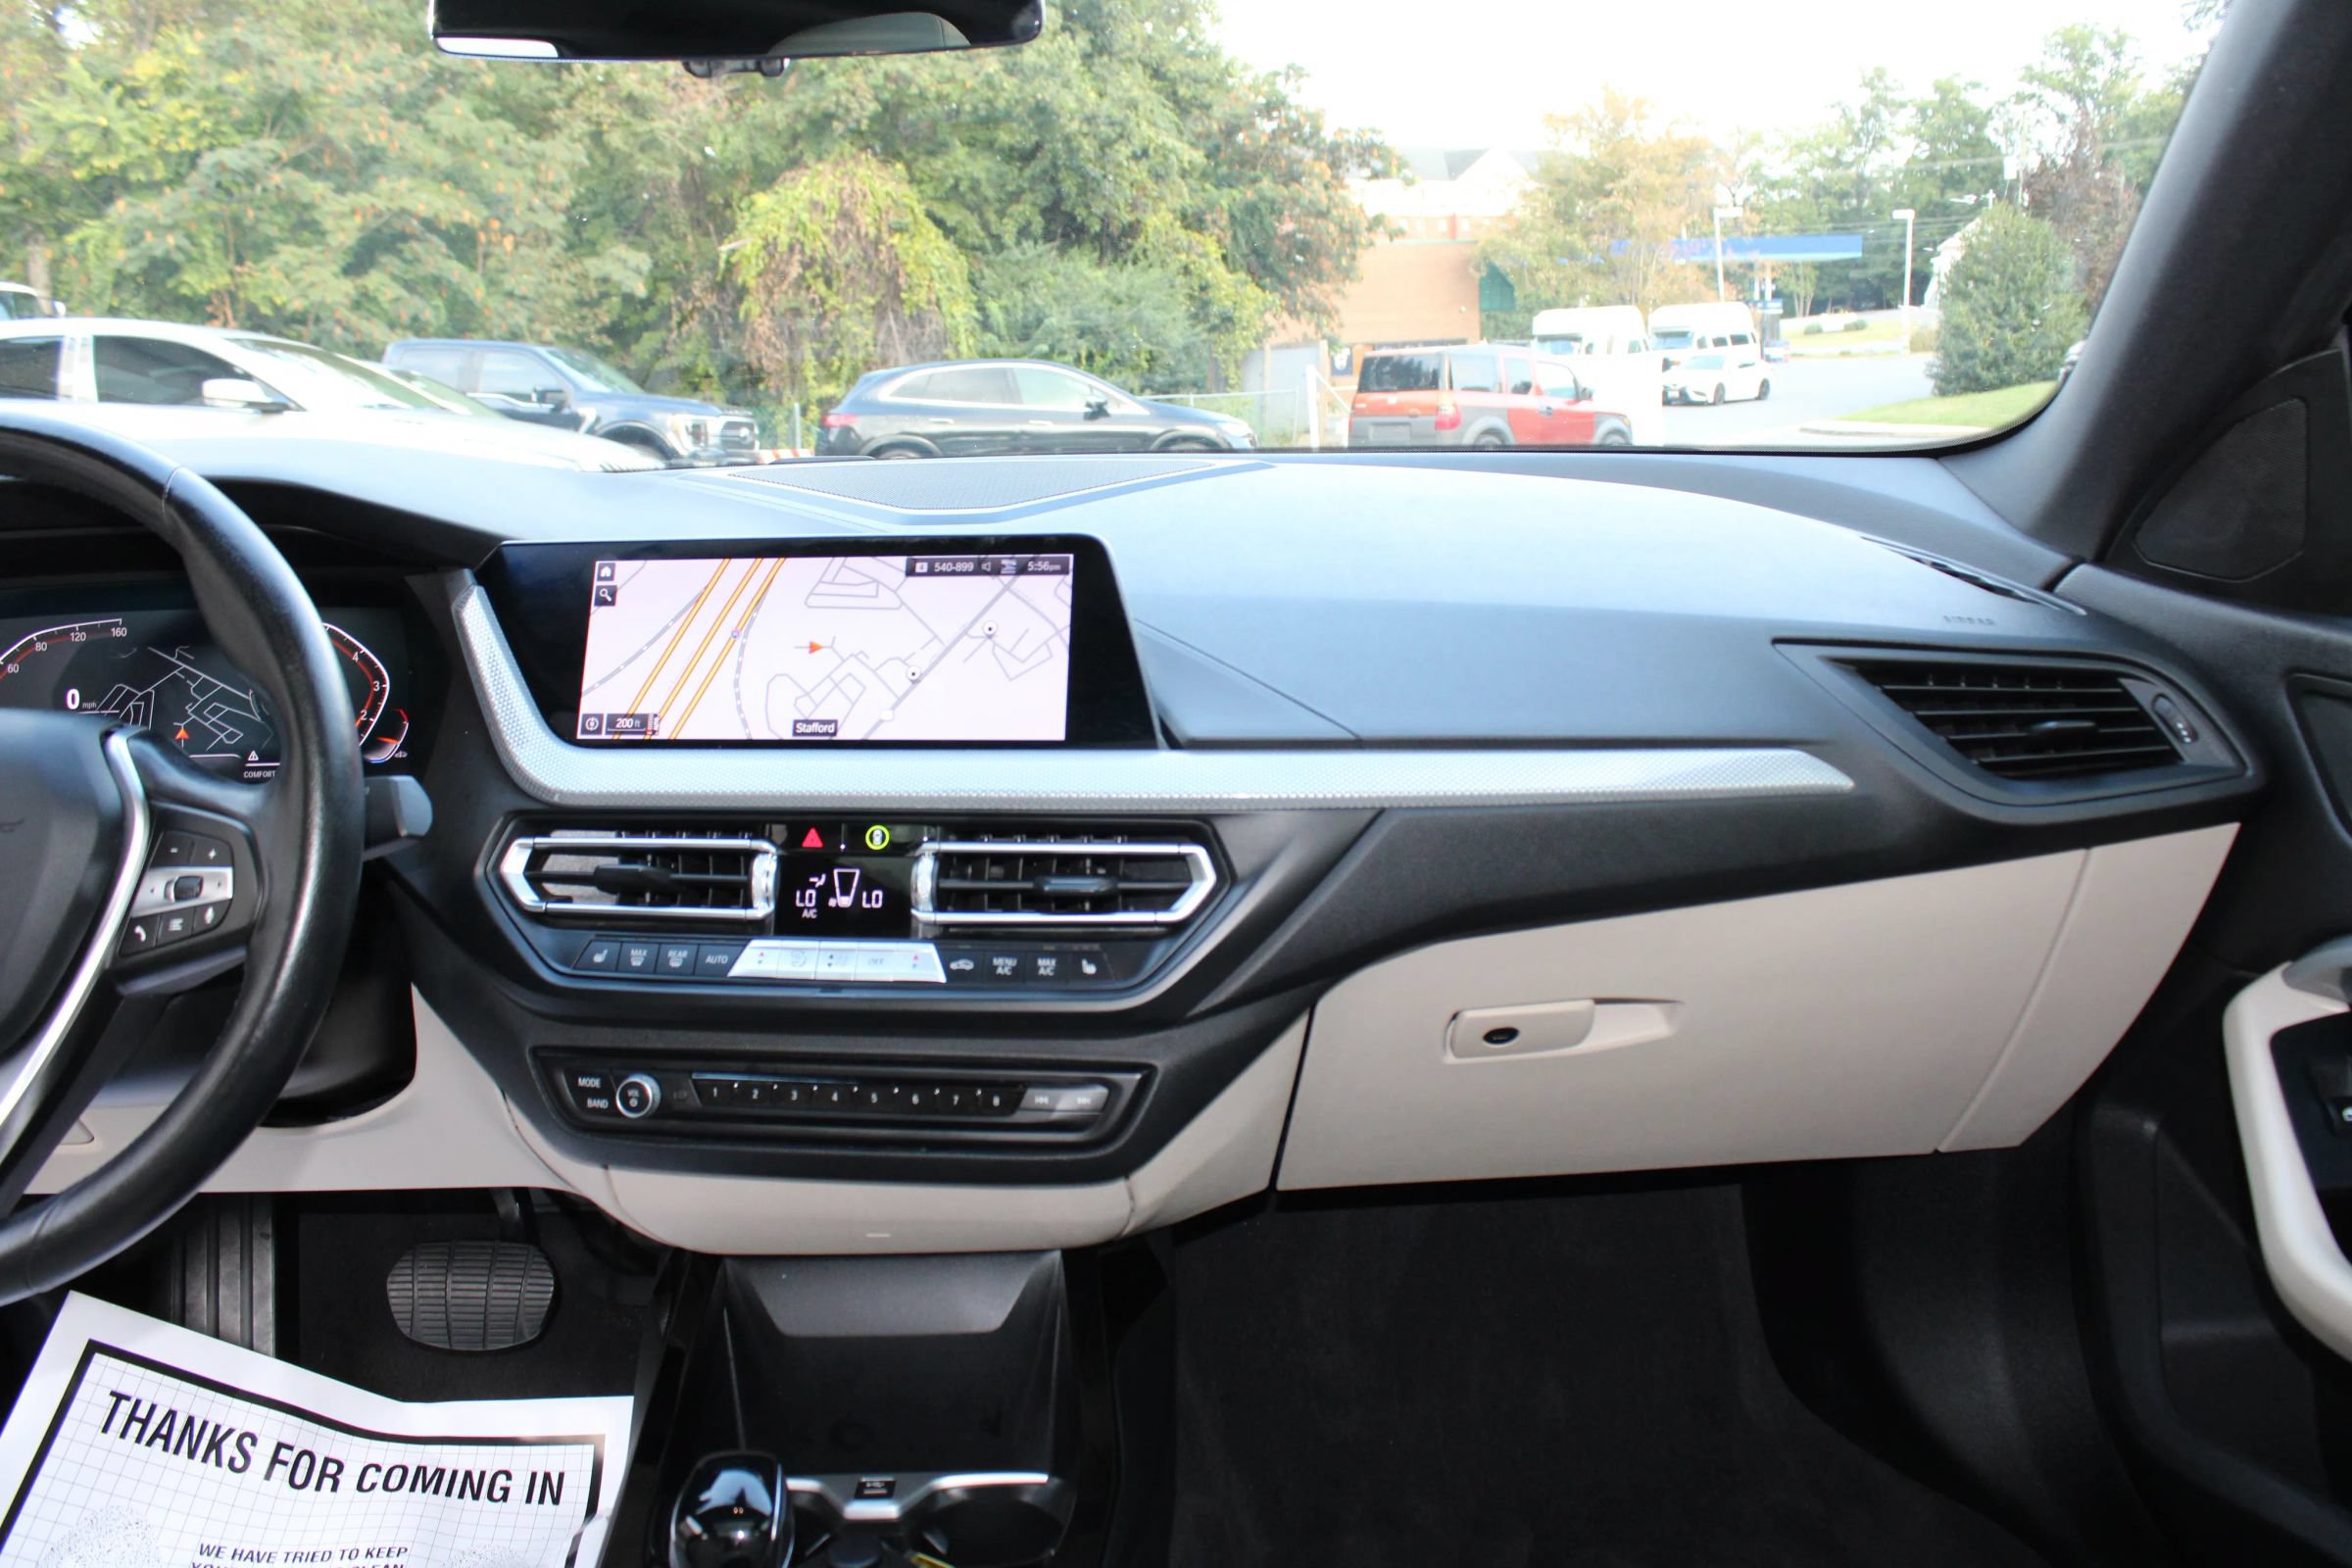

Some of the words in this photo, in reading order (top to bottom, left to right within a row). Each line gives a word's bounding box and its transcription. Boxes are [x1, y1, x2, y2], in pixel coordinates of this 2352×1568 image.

[934, 562, 974, 572] 540-899
[70, 631, 87, 642] 120
[111, 627, 127, 637] 160
[35, 641, 48, 652] 80
[352, 652, 359, 662] 4
[7, 663, 20, 673] 60
[372, 680, 380, 692] 3
[66, 688, 80, 710] 0
[82, 700, 97, 710] mph
[360, 710, 368, 721] 2
[614, 717, 634, 729] 200
[795, 721, 835, 734] Stafford
[243, 769, 275, 778] COMFORT
[795, 889, 816, 907] LO
[861, 889, 884, 908] LO
[801, 908, 818, 919] A/C
[705, 955, 729, 965] AUTO
[996, 966, 1013, 976] A/C
[1038, 967, 1055, 977] A/C
[577, 1077, 602, 1089] MODE
[712, 1087, 718, 1099] 1
[752, 1089, 760, 1100] 2
[791, 1090, 798, 1102] 3
[870, 1092, 878, 1103] 5
[953, 1094, 959, 1105] 7
[587, 1098, 610, 1109] BAND
[100, 1390, 259, 1474] THANKS
[264, 1441, 345, 1494] FOR
[356, 1462, 513, 1503] COMING
[524, 1470, 565, 1506] IN
[199, 1543, 227, 1558] WE
[230, 1547, 277, 1564] HAVE
[283, 1549, 332, 1563] TRIED
[339, 1547, 360, 1561] TO
[365, 1546, 409, 1559] KEEP
